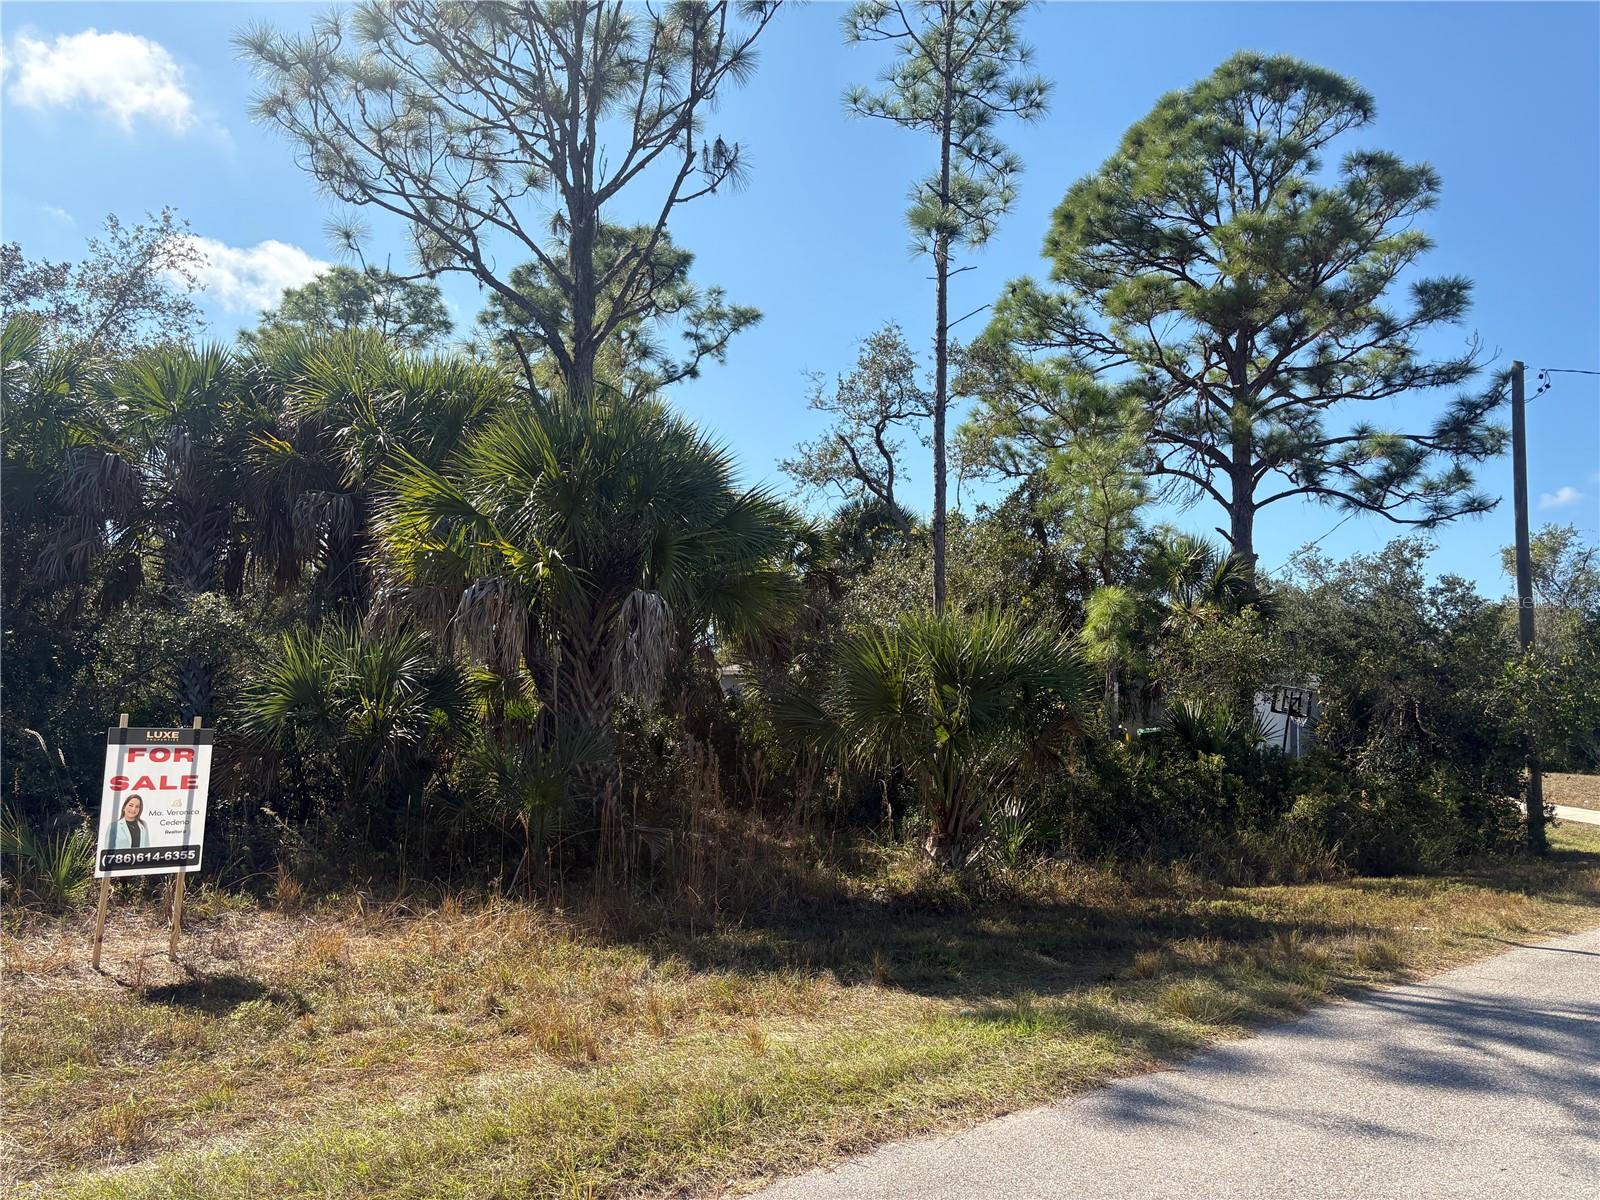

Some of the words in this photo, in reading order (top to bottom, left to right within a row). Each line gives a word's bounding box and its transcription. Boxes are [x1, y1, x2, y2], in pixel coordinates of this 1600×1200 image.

[147, 731, 180, 739] LUXE
[128, 747, 195, 763] FOR
[110, 775, 199, 791] SALE
[166, 808, 200, 816] Veronica
[101, 849, 196, 867] (786)614-6355
